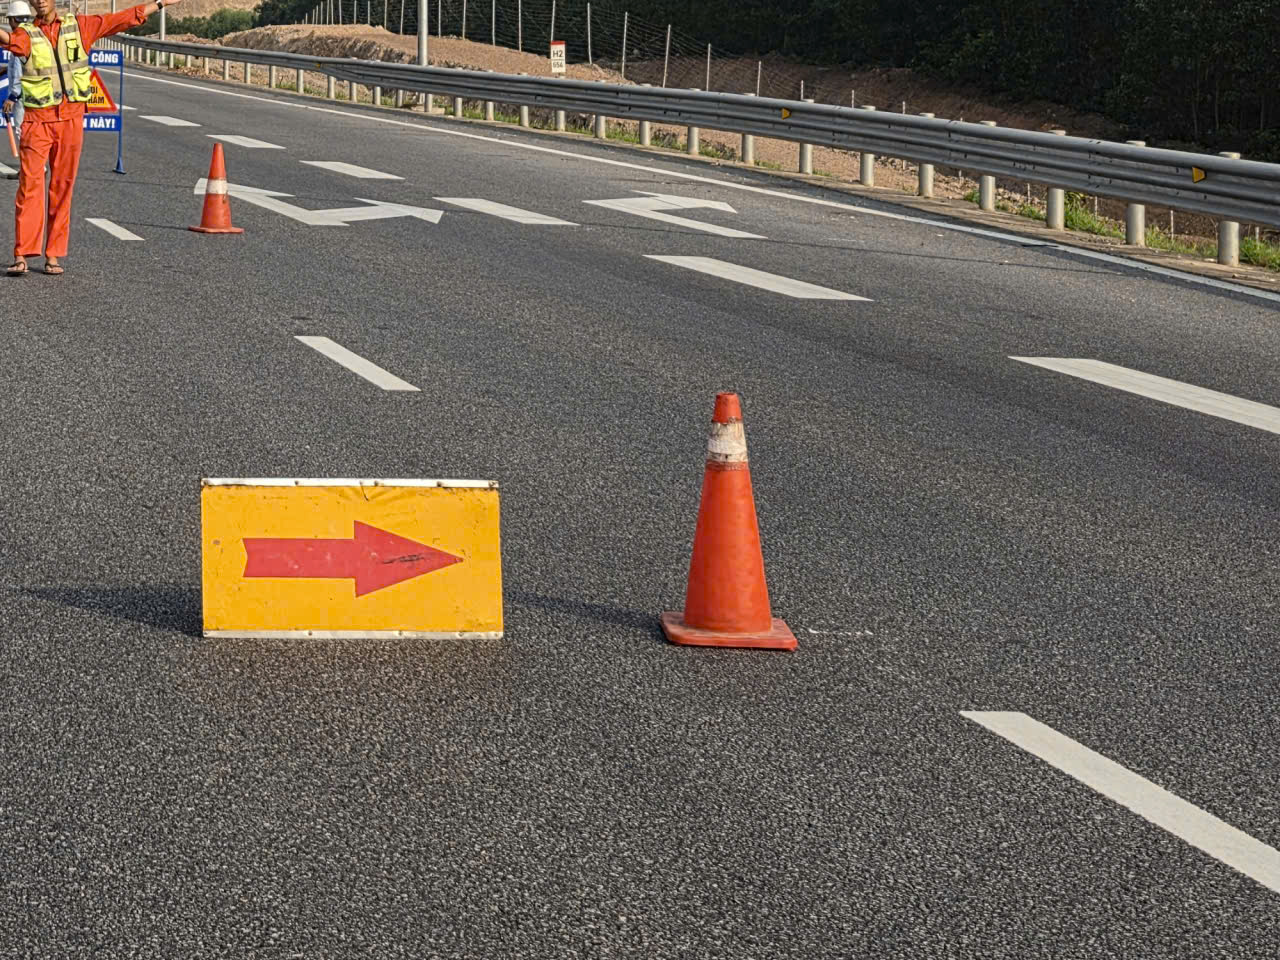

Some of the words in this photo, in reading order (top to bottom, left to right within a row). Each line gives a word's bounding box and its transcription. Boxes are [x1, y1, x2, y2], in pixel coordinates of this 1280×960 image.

[91, 51, 119, 64] CÔNG
[553, 50, 563, 58] H2
[90, 116, 116, 129] NÀY!
